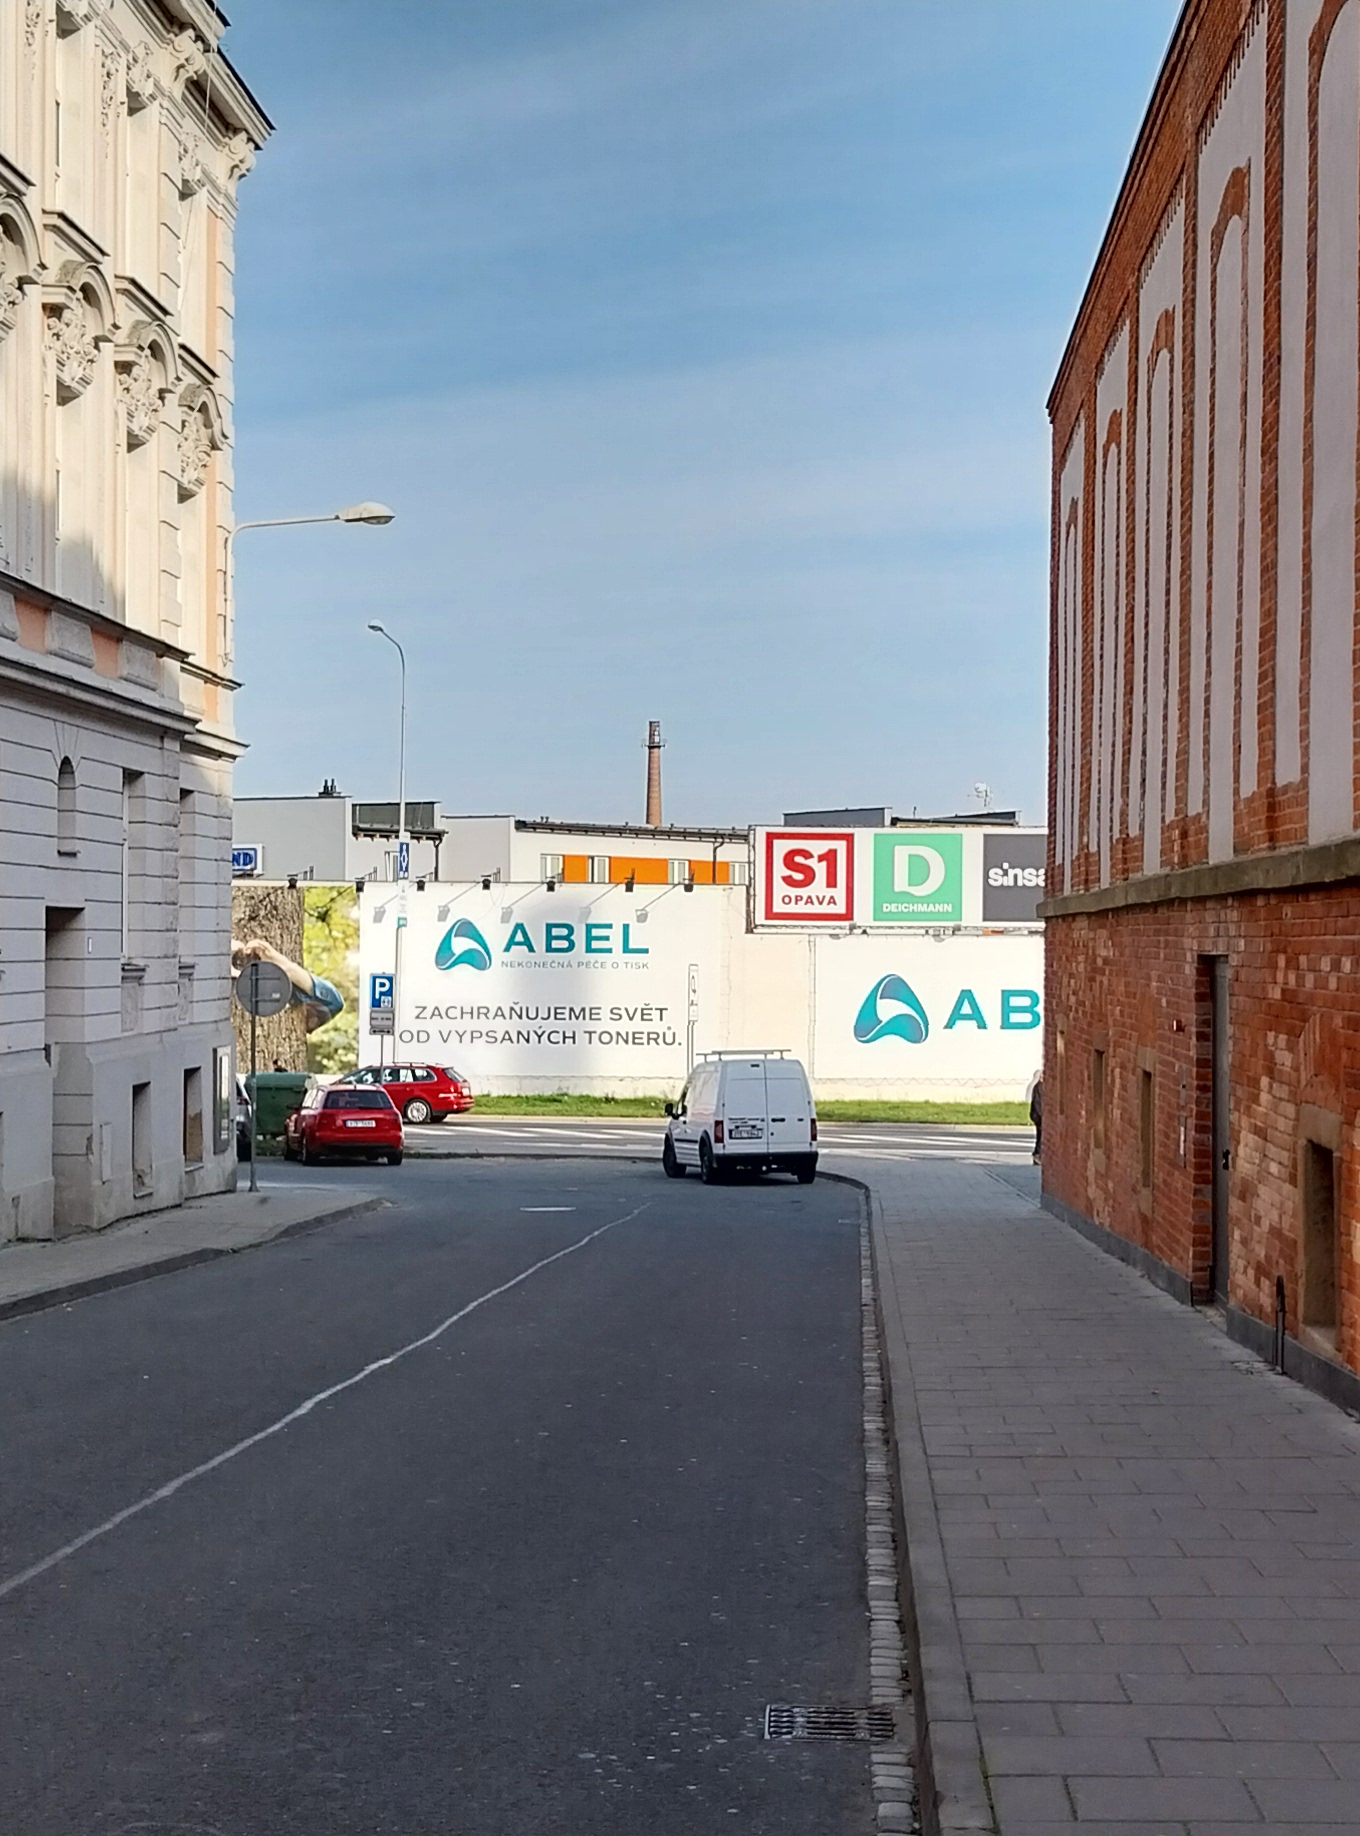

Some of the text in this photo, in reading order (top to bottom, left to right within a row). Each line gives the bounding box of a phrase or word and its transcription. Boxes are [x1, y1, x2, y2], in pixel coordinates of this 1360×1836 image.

[780, 848, 838, 889] S1
[893, 844, 946, 897] D
[781, 894, 838, 906] OPAVA
[882, 902, 952, 913] DEICHMANN
[502, 922, 650, 954] ABEL
[501, 959, 650, 970] NEKONEČNÁ PÉČE O TISK
[375, 977, 391, 999] P
[414, 1001, 668, 1022] ZACHRAŇUJEME SVĚT
[398, 1025, 682, 1046] OD VYPSANÝCH TONERŮ.
